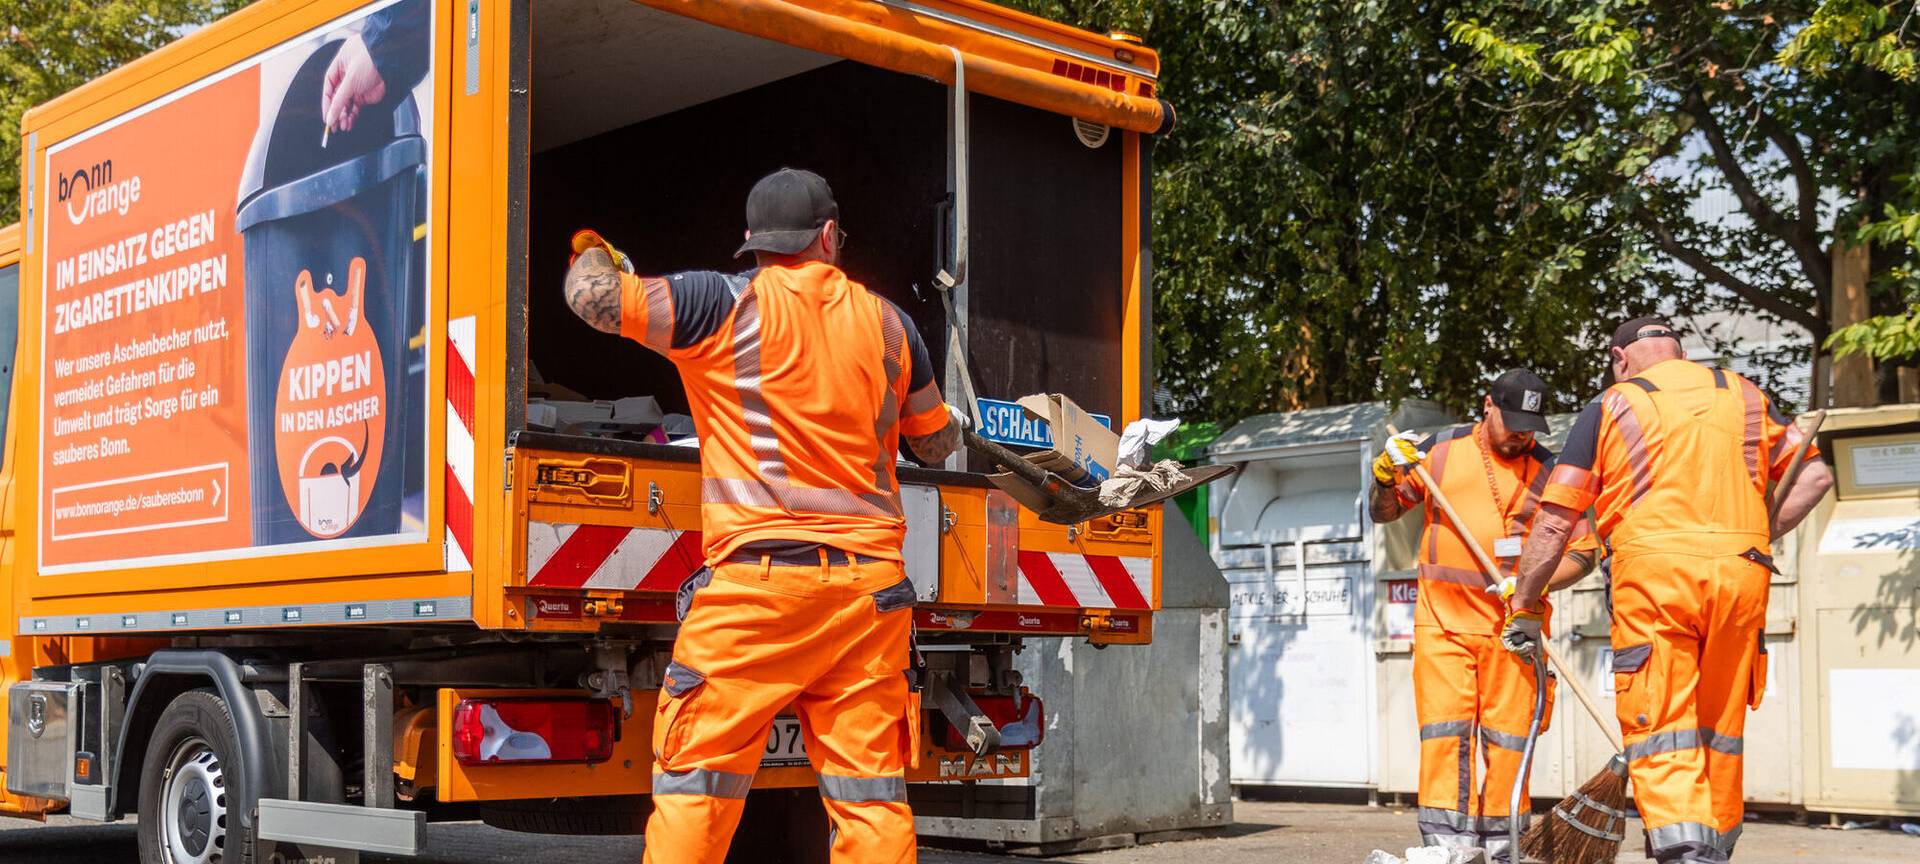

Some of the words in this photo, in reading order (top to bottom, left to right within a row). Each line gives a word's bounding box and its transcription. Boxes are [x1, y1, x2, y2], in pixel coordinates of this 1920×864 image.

[56, 257, 75, 291] IM
[78, 232, 148, 284] EINSATZ
[151, 209, 215, 260] GEGEN
[54, 254, 228, 335] ZIGARETTENKIPPEN
[55, 359, 74, 379] Wer
[76, 351, 111, 373] unsere
[112, 327, 193, 365] Aschenbecher
[194, 317, 229, 344] nutzt,
[54, 379, 105, 407] vermeidet
[106, 370, 156, 396] Gefahren
[158, 361, 176, 382] für
[177, 357, 195, 379] die
[289, 351, 371, 402] KIPPEN
[54, 412, 92, 437] Umwelt
[93, 406, 113, 429] und
[115, 401, 142, 426] trägt
[144, 396, 178, 420] Sorge
[180, 390, 198, 412] für
[200, 384, 219, 407] ein
[281, 412, 295, 433] IN
[297, 409, 324, 432] DEN
[326, 395, 380, 428] ASCHER
[53, 443, 99, 466] sauberes
[100, 436, 130, 457] Bonn.
[55, 487, 204, 520] www.bonnorange.de/sauberesbonn
[940, 754, 1021, 777] MAN
